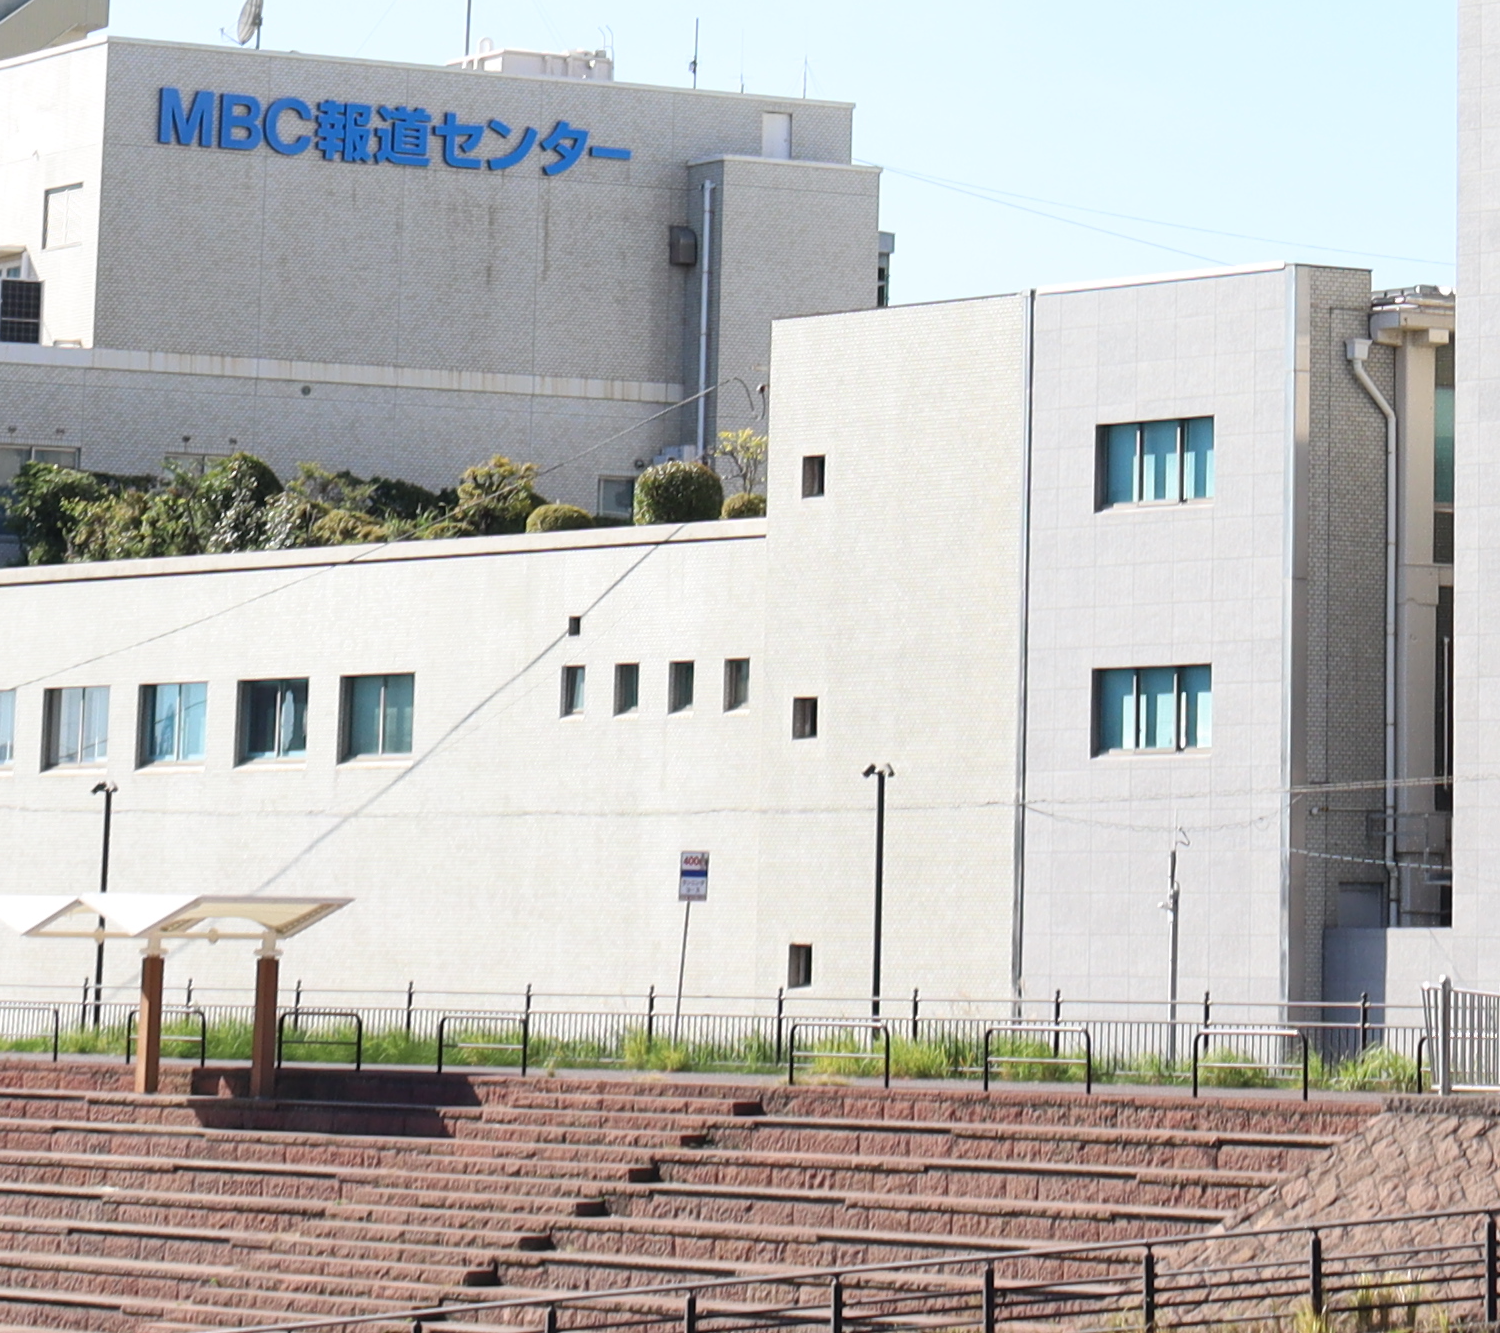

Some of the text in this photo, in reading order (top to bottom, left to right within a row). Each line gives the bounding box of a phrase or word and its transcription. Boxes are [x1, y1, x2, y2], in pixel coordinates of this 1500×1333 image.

[157, 86, 632, 177] MBC報道センター
